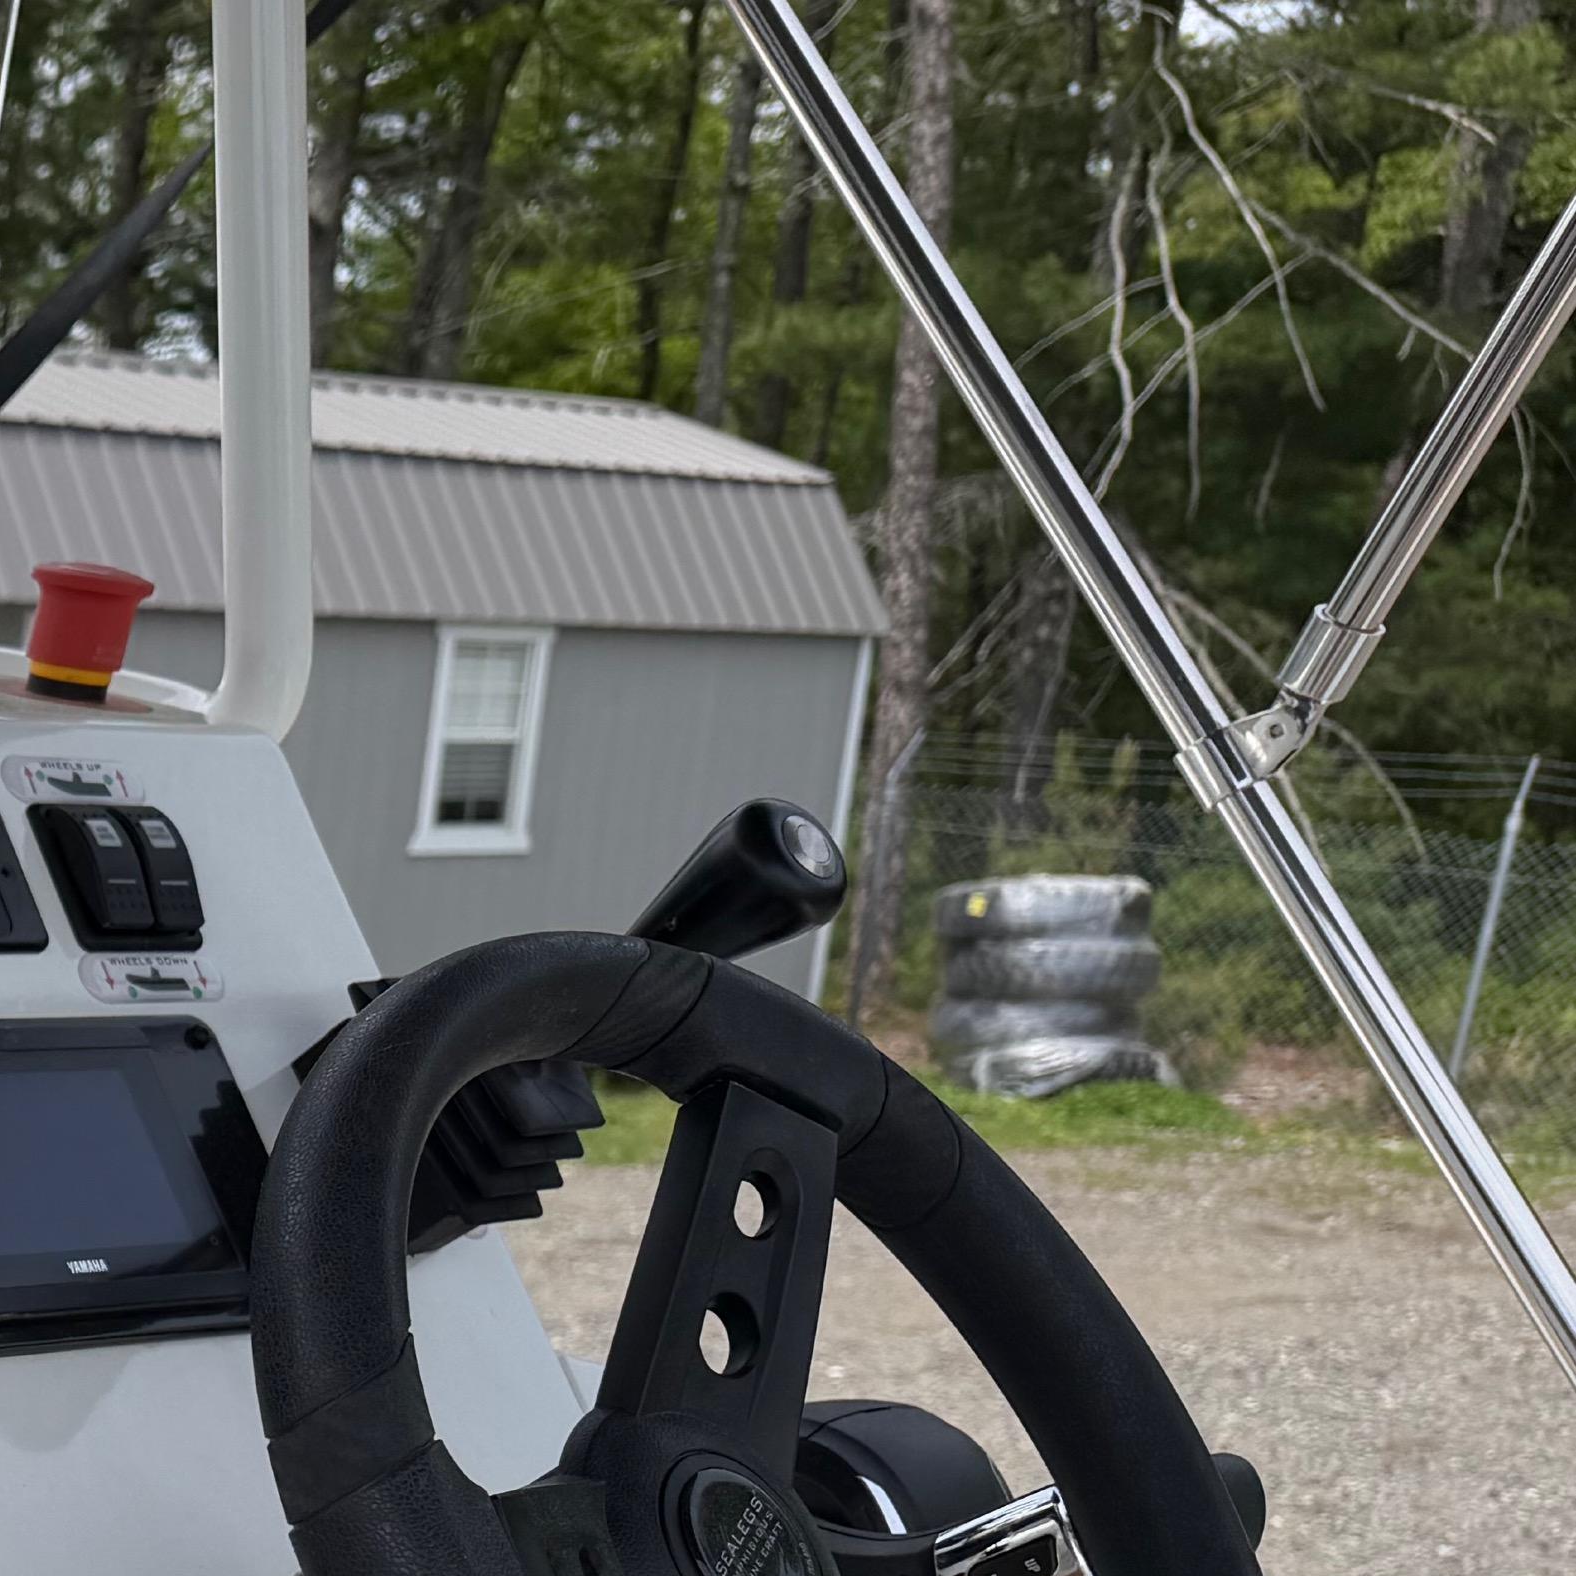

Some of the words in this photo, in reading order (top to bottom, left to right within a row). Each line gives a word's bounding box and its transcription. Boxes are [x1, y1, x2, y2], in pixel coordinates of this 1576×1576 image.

[39, 761, 83, 771] WHEELS
[87, 763, 101, 771] UP
[109, 957, 153, 966] WHEELS
[156, 957, 188, 966] DOWN
[67, 1259, 108, 1275] YAMAHA
[761, 1522, 783, 1559] CRAFT
[1024, 1558, 1041, 1573] UP
